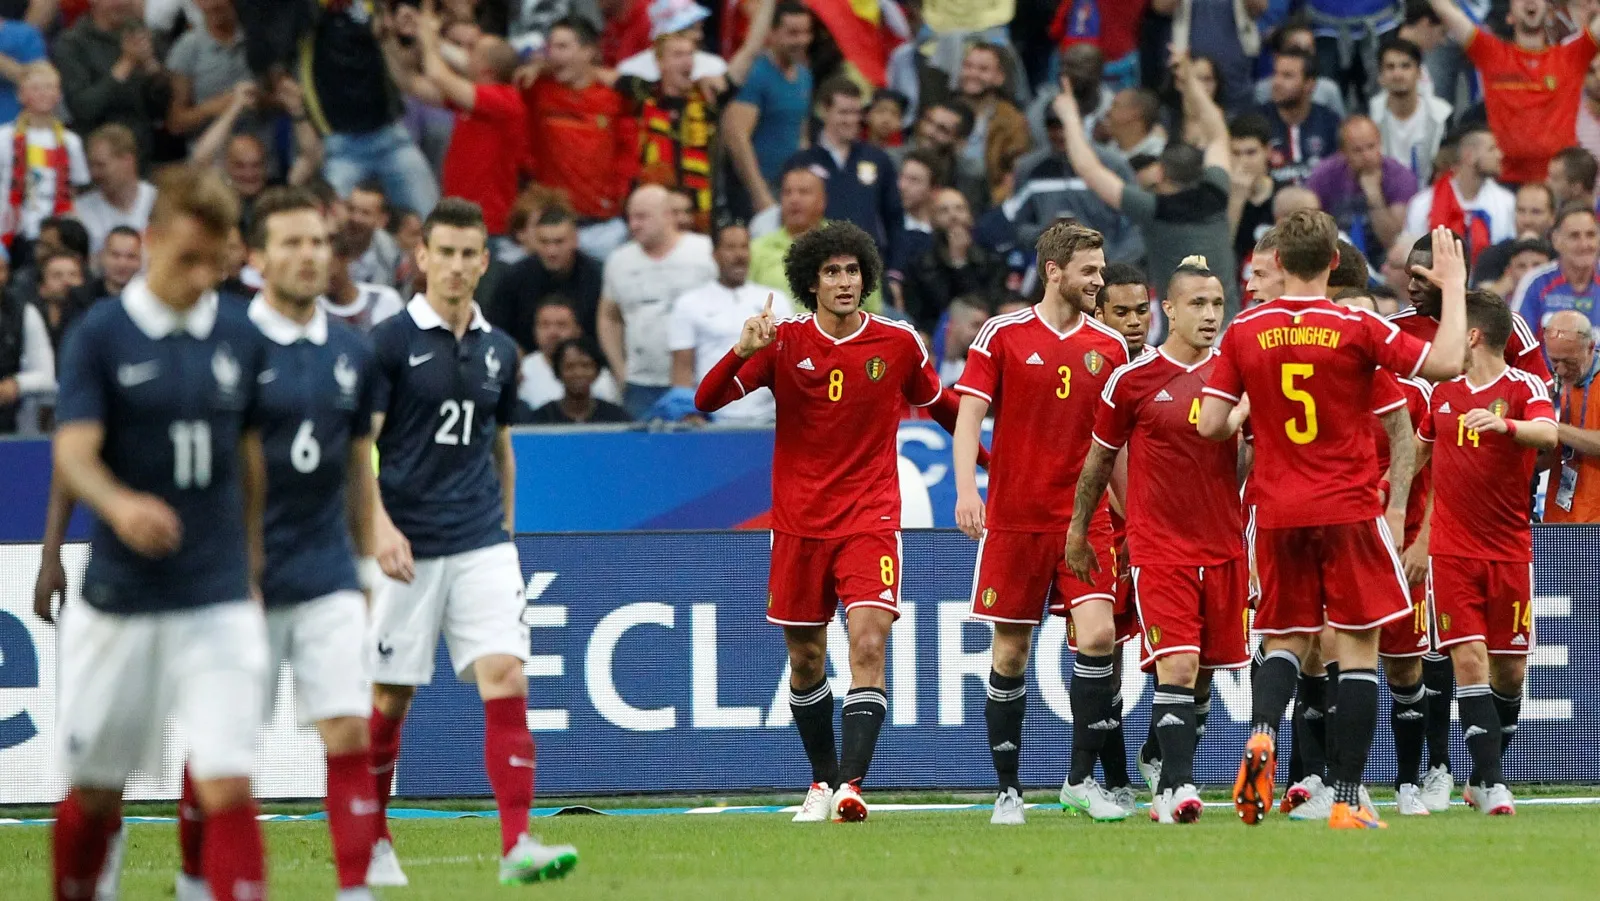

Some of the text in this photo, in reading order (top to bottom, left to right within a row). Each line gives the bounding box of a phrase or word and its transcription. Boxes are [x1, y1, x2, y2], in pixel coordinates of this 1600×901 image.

[1257, 326, 1340, 350] VERTONGHEN
[828, 369, 844, 401] 8
[1056, 365, 1072, 399] 3
[1281, 363, 1318, 445] 5
[435, 400, 475, 446] 21
[1457, 413, 1480, 448] 14
[169, 420, 213, 490] 11
[290, 419, 321, 474] 6
[880, 555, 895, 586] 8
[1413, 600, 1427, 634] 10
[1512, 600, 1531, 633] 14
